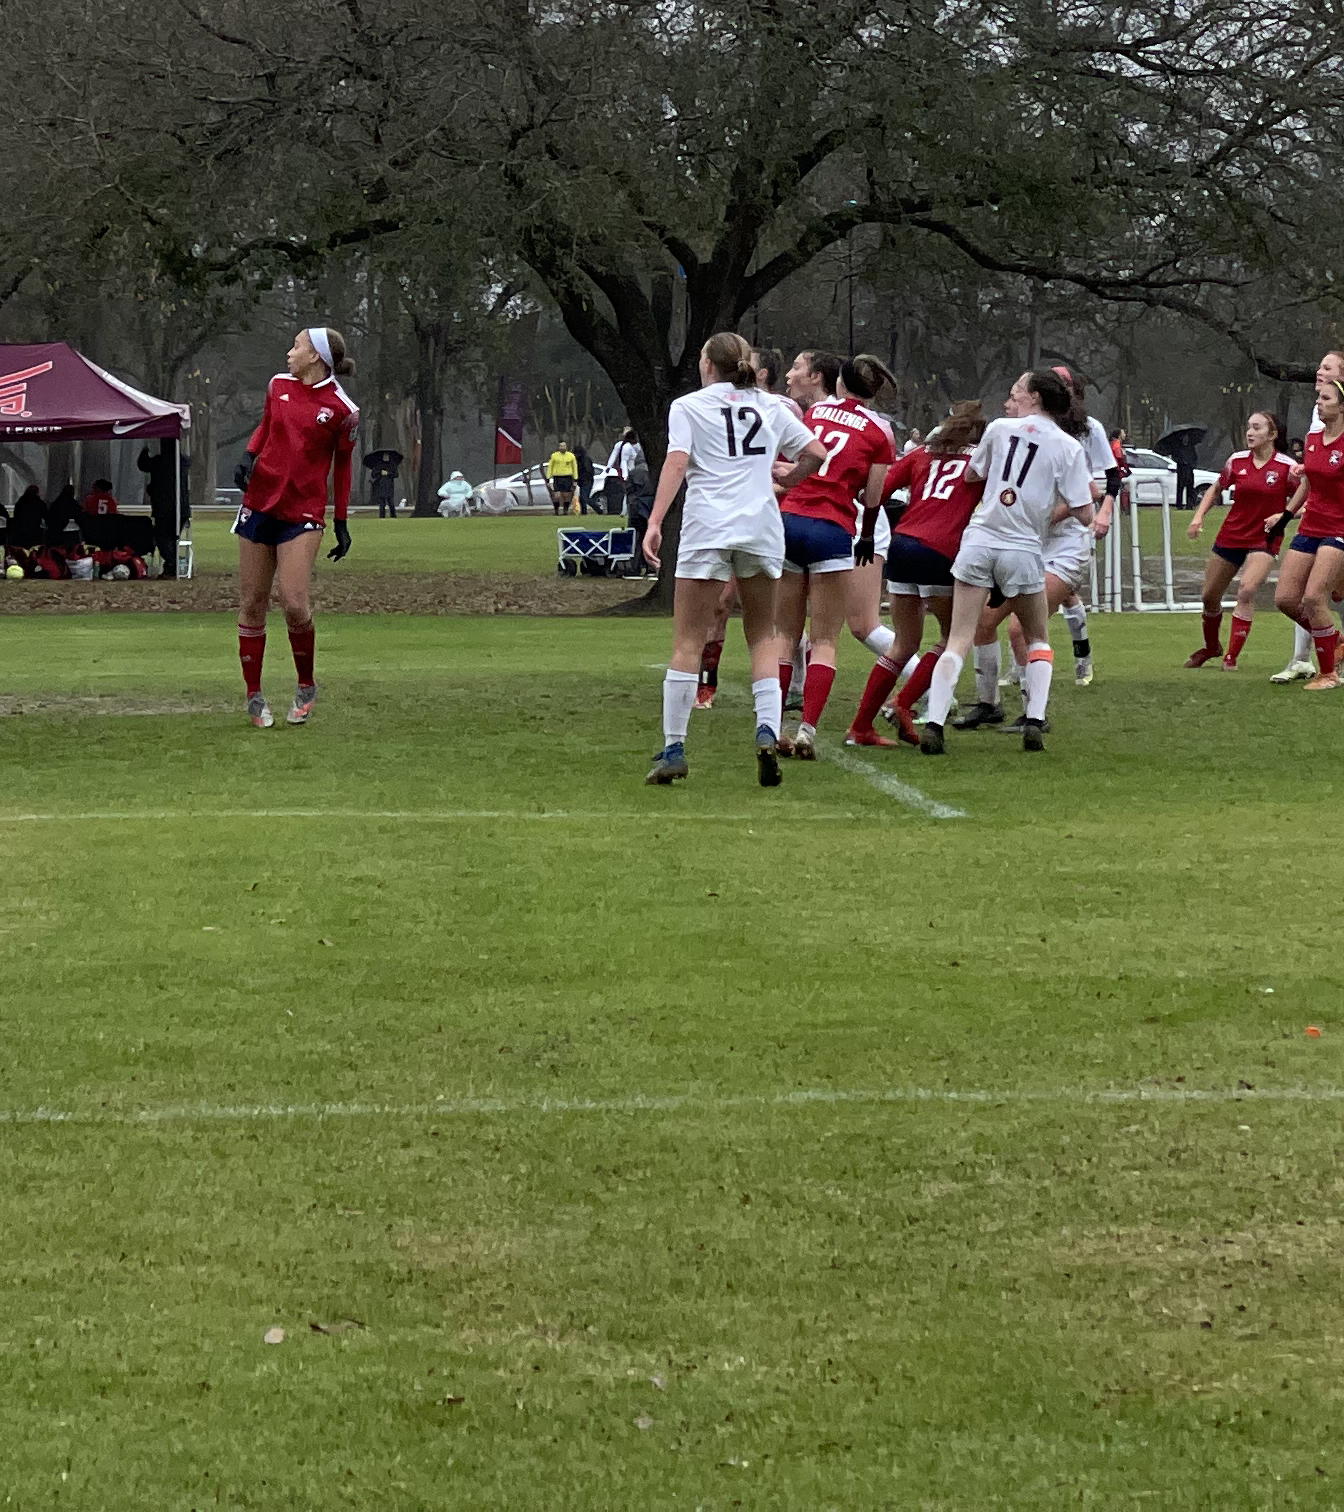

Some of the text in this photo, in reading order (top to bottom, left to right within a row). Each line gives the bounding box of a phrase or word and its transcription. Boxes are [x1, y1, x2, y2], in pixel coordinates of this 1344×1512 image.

[720, 406, 767, 457] 12
[811, 405, 869, 432] CHALLENGE
[921, 459, 967, 501] 12
[1002, 435, 1039, 488] 11
[97, 499, 108, 515] 5
